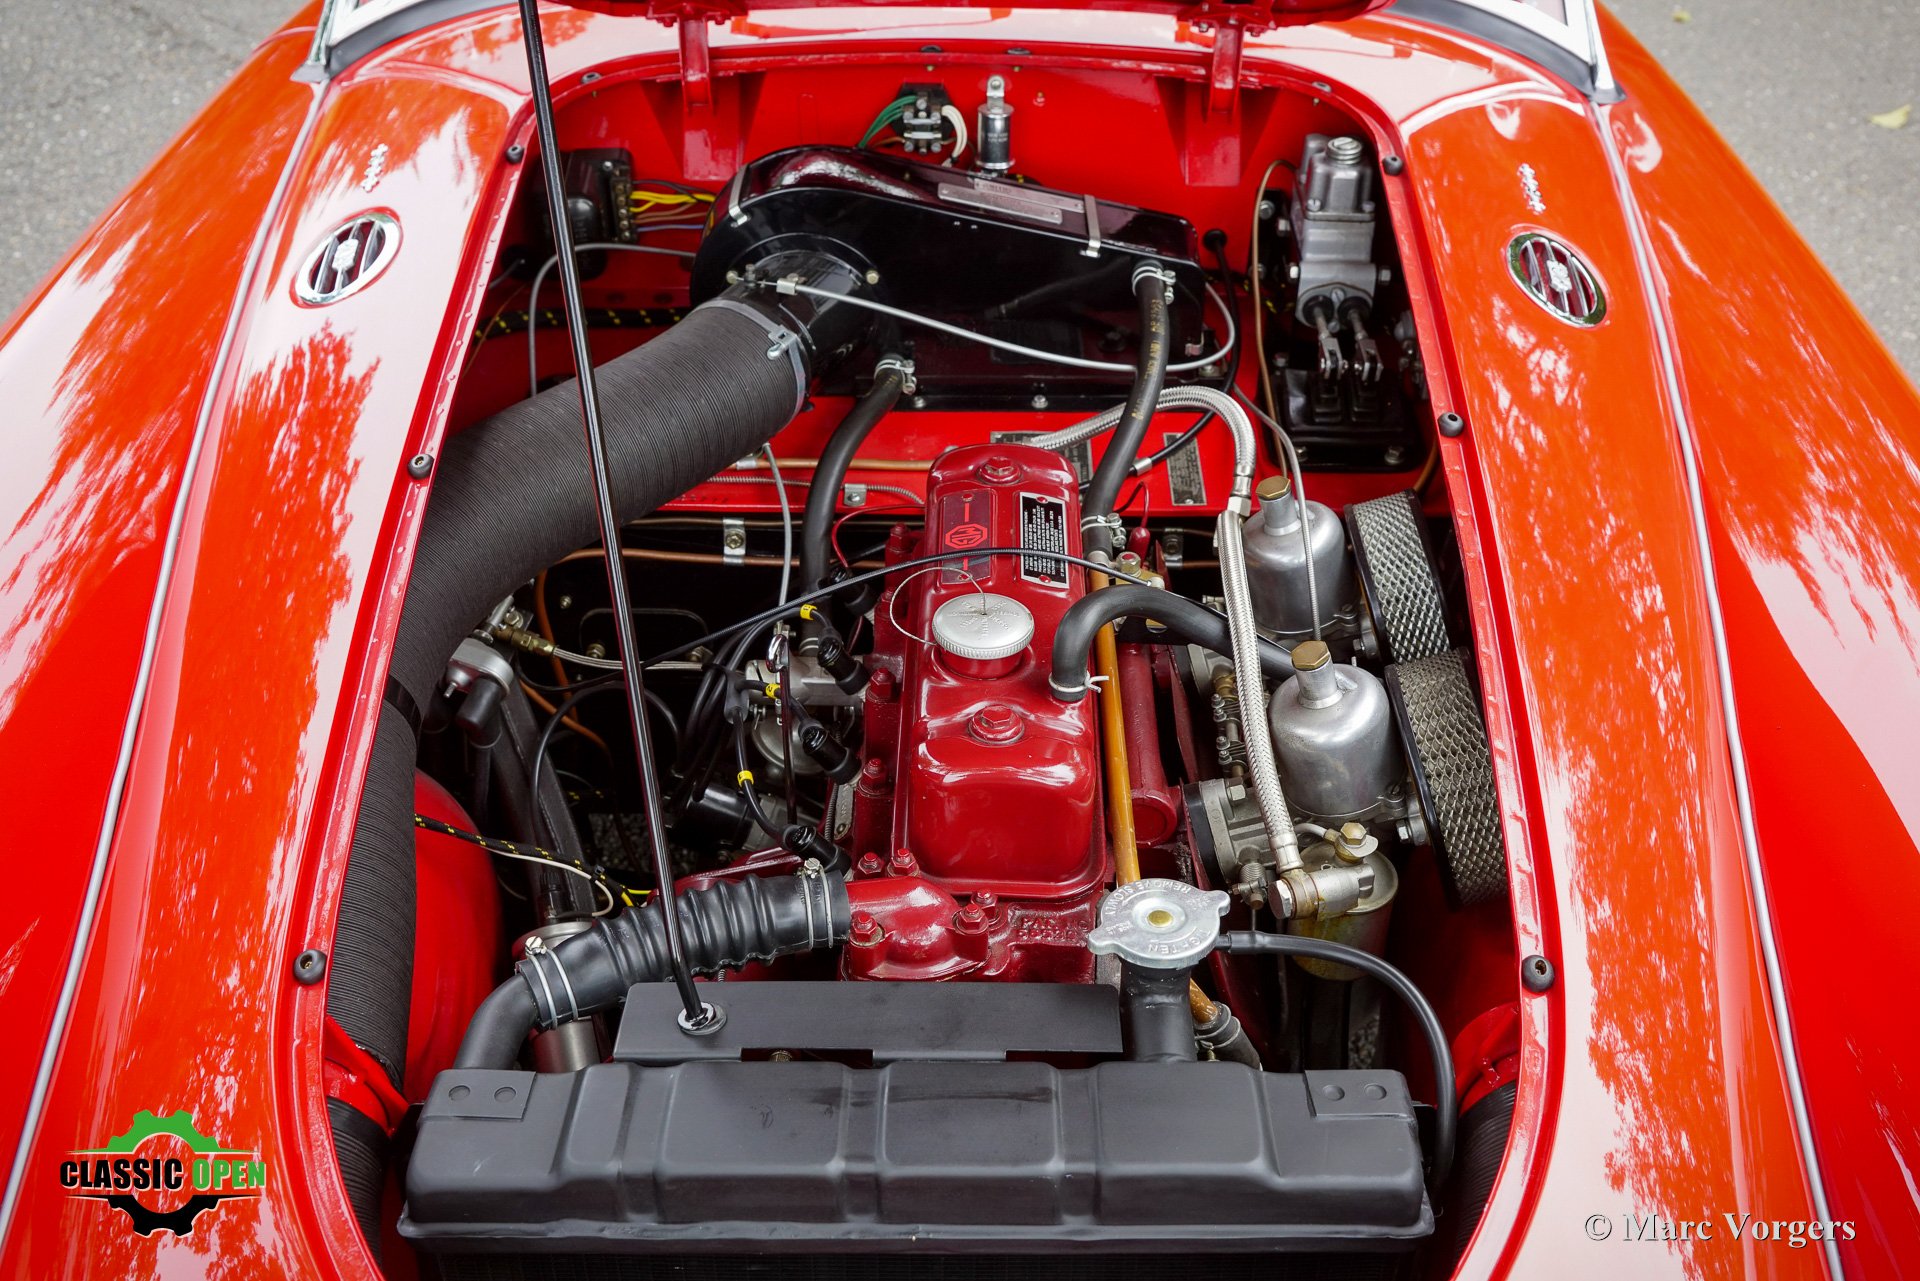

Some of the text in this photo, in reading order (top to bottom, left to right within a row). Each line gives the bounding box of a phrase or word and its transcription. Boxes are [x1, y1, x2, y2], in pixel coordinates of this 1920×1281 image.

[949, 526, 984, 547] MG
[1104, 879, 1191, 916] REMOVE SLOWLY
